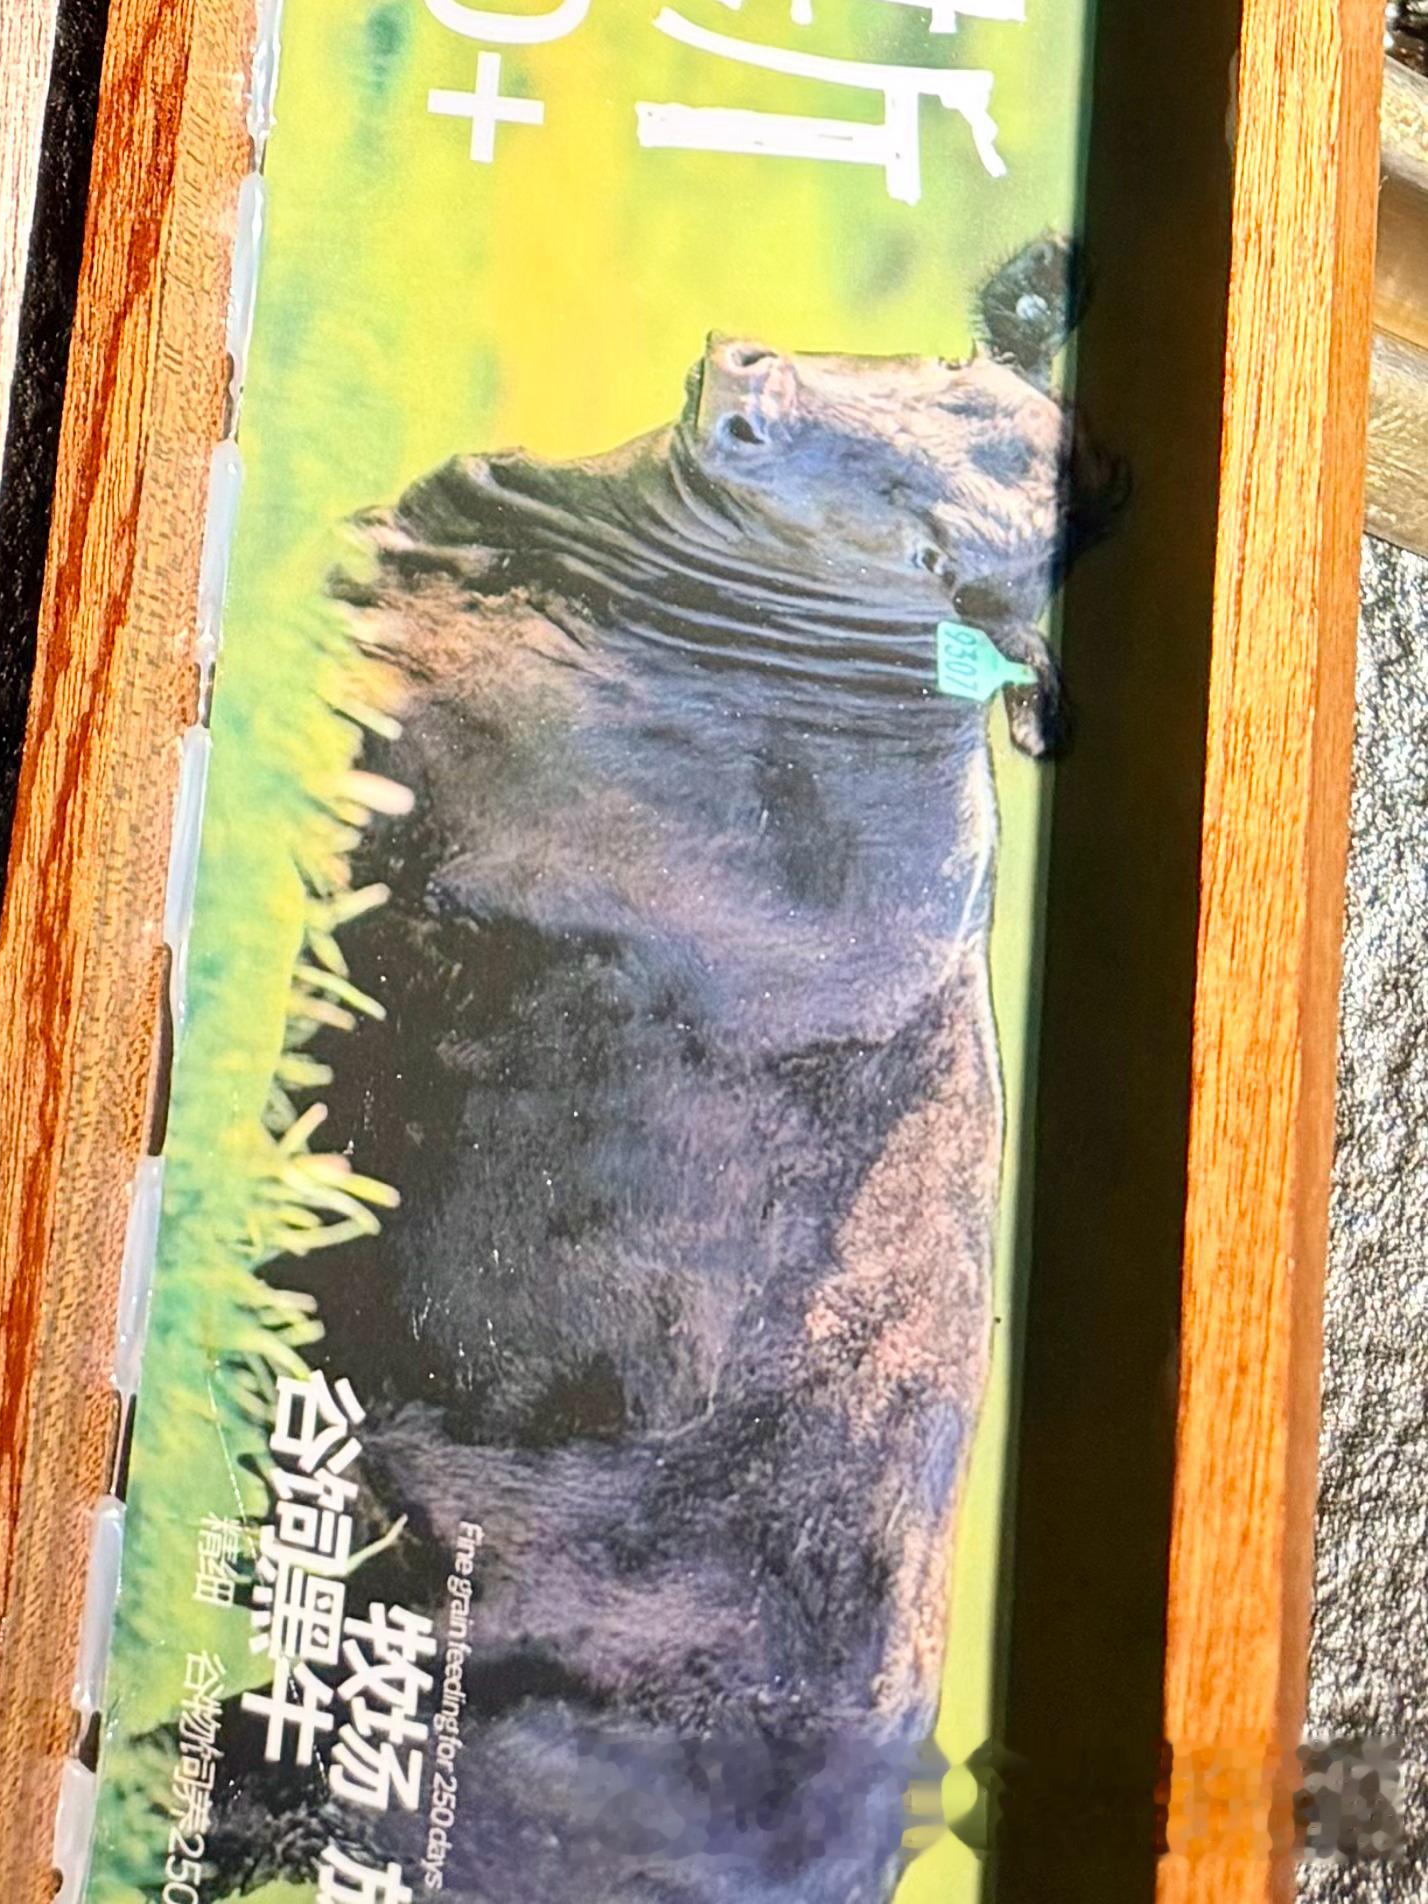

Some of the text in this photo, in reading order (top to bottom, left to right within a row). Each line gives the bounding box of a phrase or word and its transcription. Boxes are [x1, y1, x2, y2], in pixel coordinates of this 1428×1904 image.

[193, 1511, 251, 1609] 精细
[241, 1370, 370, 1767] 谷饲黑牛
[328, 1601, 437, 1811] 牧场
[424, 1520, 484, 1891] Fine grain feeding for 250 days
